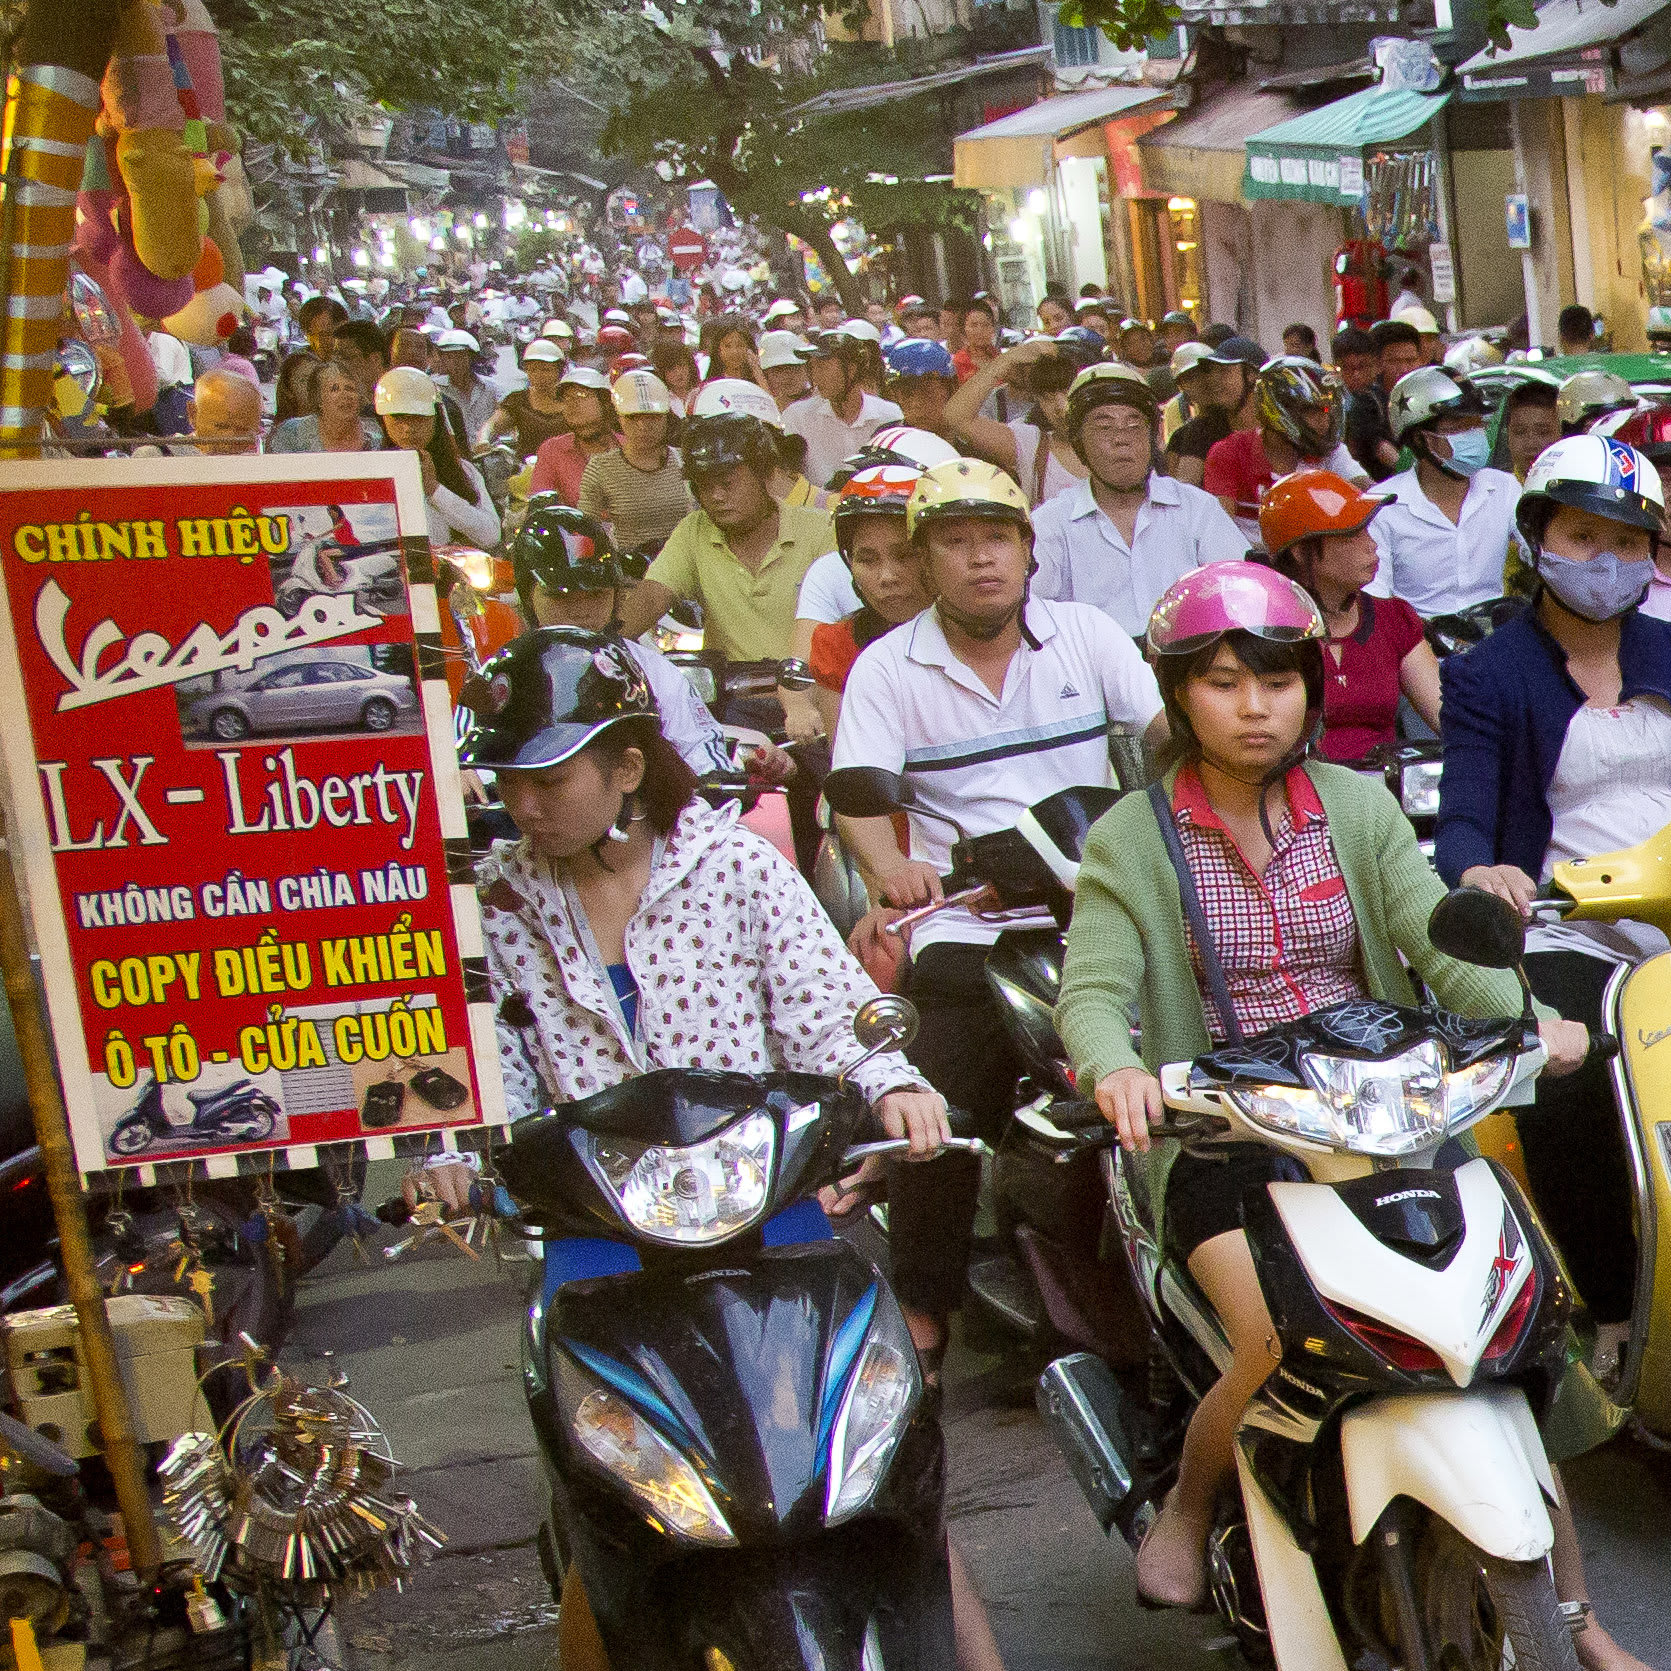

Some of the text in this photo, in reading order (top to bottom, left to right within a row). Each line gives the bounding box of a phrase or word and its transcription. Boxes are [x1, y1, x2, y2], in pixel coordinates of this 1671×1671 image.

[14, 511, 291, 565] CHÍNH HIỆU
[33, 577, 386, 712] Vespa
[218, 748, 425, 849] Liberty
[78, 862, 428, 930] KHÔNG CẦN CHÌA NÂU
[90, 913, 447, 1009] COPY ĐIỀU KHIỂN
[106, 1029, 137, 1088] Ô
[145, 1023, 200, 1083] TÔ
[239, 1004, 324, 1074] CỬA
[333, 992, 448, 1064] CUỐN
[1375, 1189, 1441, 1207] HONDA
[1279, 1367, 1328, 1400] HONDA
